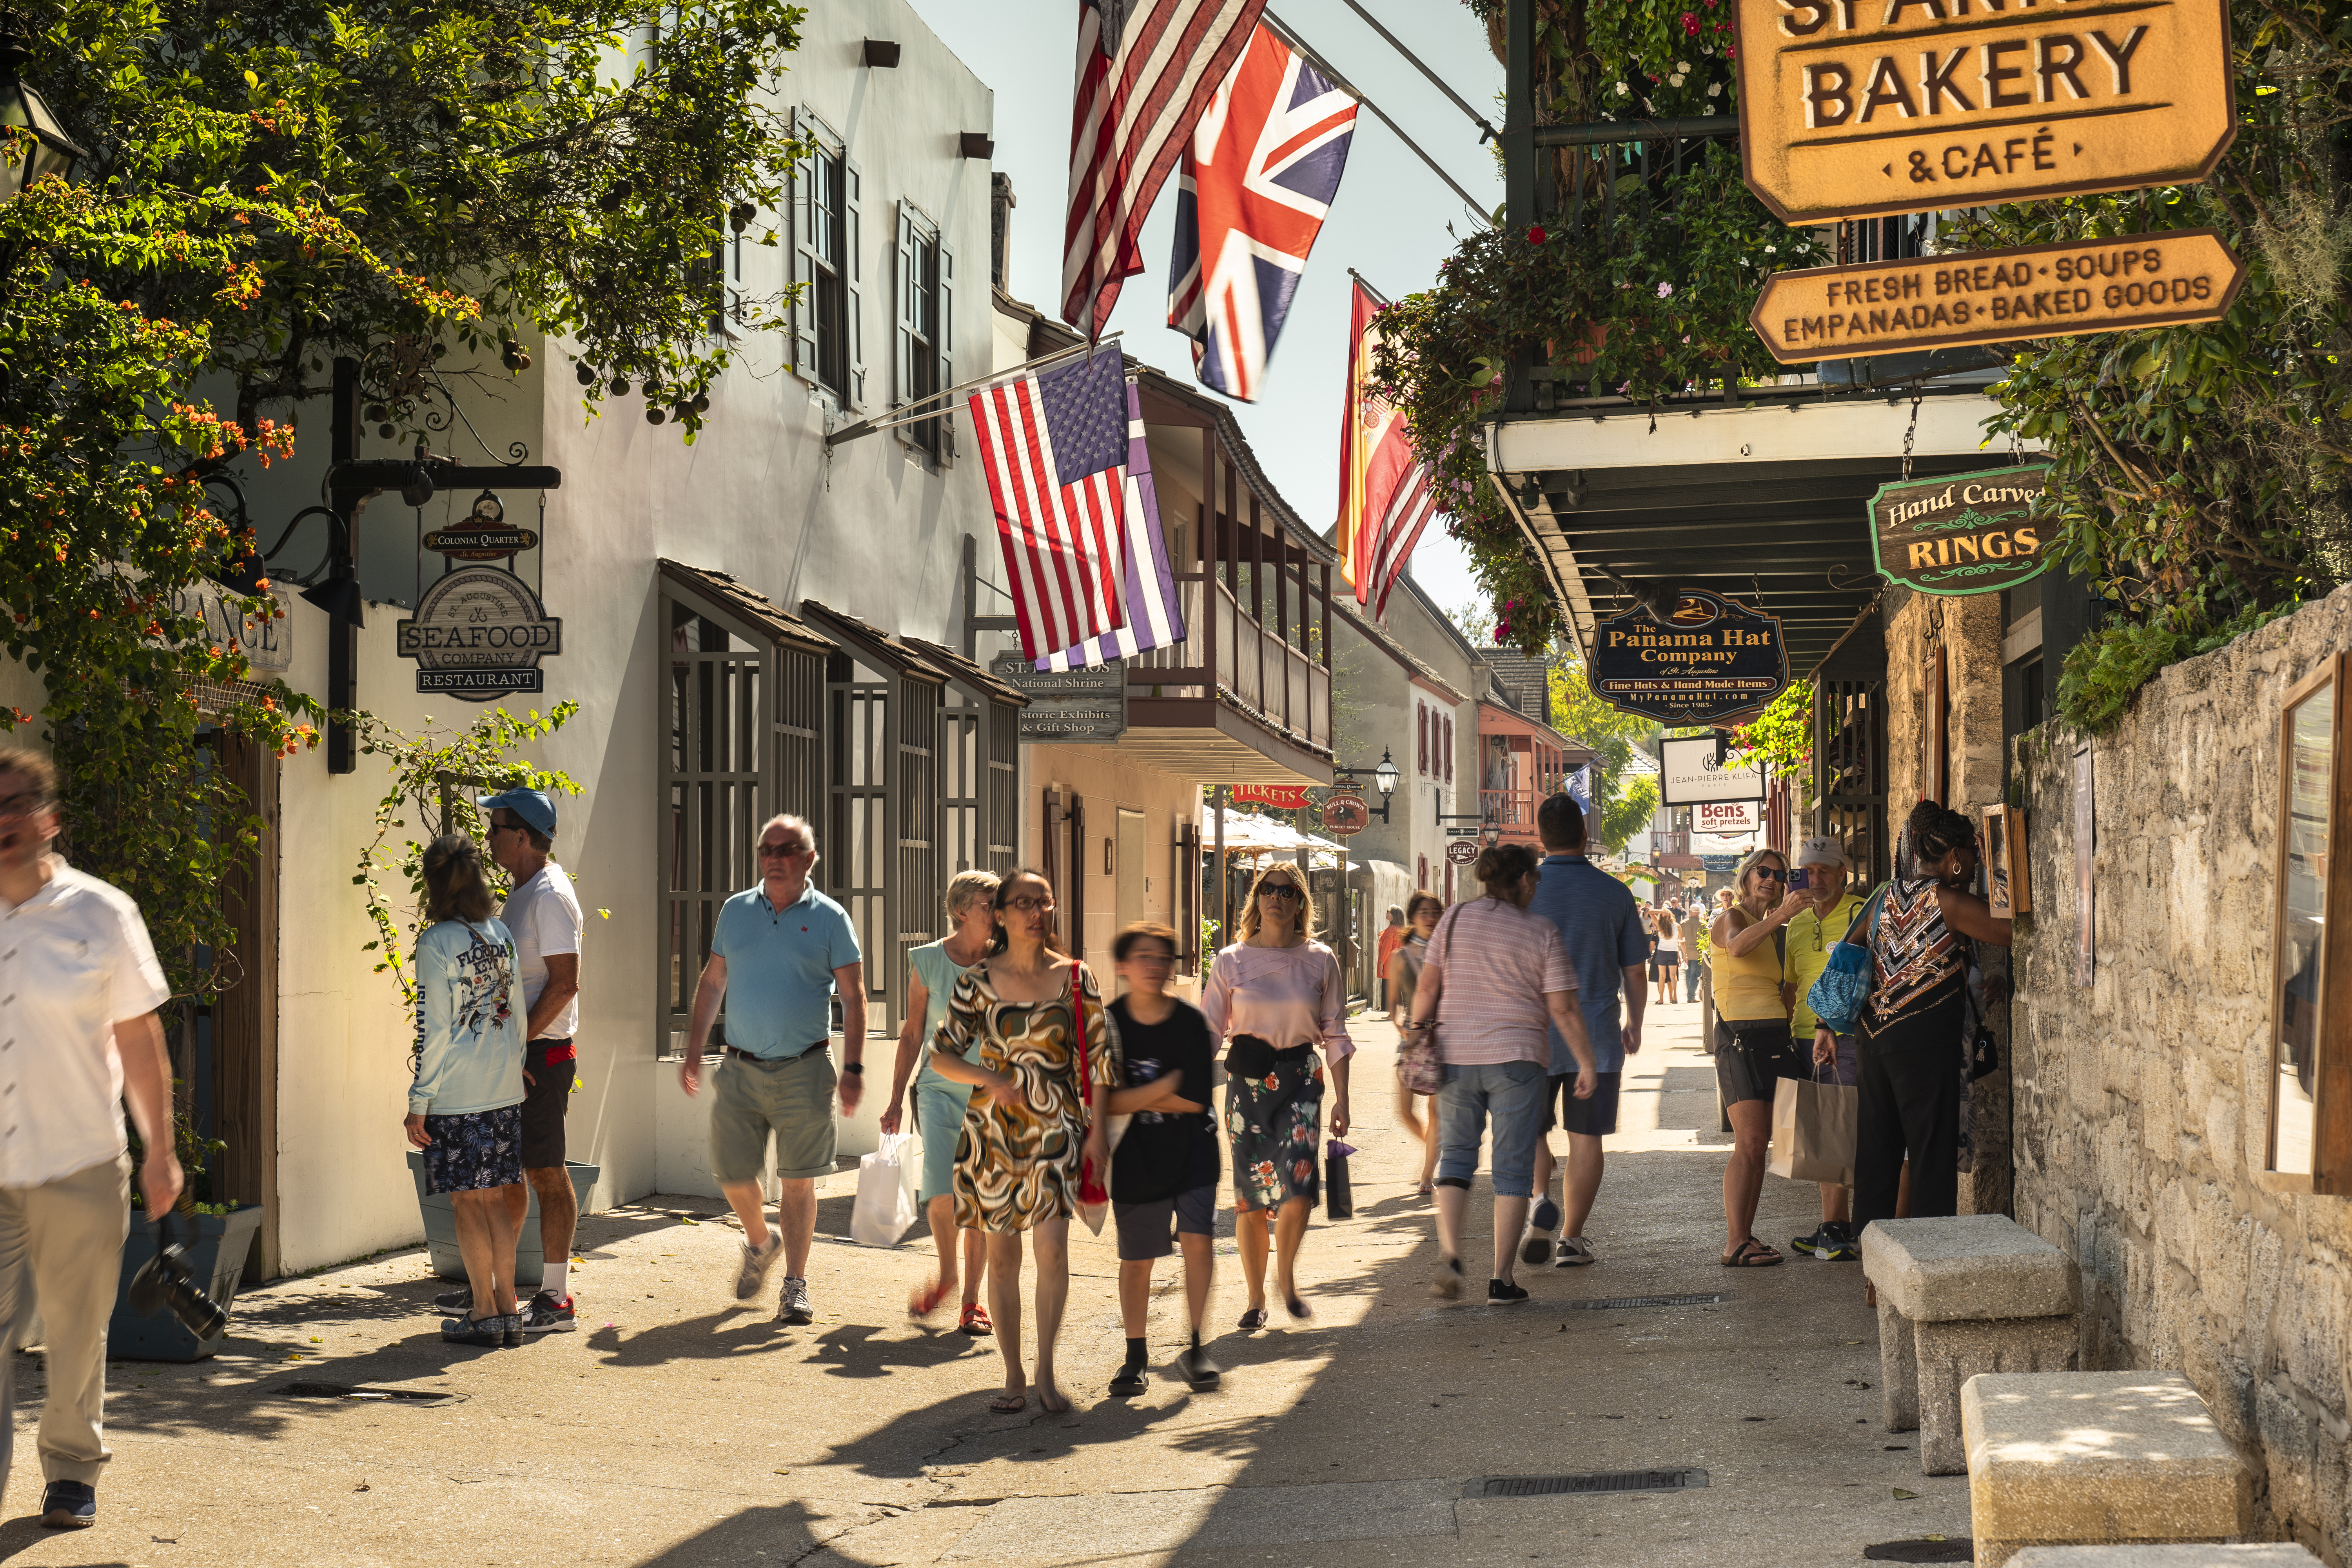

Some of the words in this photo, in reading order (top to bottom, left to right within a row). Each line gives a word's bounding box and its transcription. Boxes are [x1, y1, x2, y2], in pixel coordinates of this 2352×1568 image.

[1800, 25, 2149, 129] BAKERY
[1826, 274, 1921, 307] FRESH
[1934, 262, 2032, 296] BREAD
[2055, 248, 2161, 282] SOUPS
[1783, 301, 1969, 342] EMPANADAS
[1991, 288, 2090, 321] BAKED
[2103, 276, 2211, 309] GOODS
[1888, 484, 1956, 529] Hand
[437, 535, 478, 545] COLONIAL
[481, 535, 519, 546] QUARTER
[1907, 526, 2040, 570] RINGS
[448, 605, 460, 618] ST.
[461, 592, 508, 617] AUGUSTINE
[1633, 624, 1657, 633] The
[405, 626, 551, 649] SEAFOOD
[1608, 631, 1713, 647] Panama
[1721, 629, 1771, 646] Hat
[441, 653, 515, 664] COMPANY
[1640, 649, 1737, 665] Company
[1005, 662, 1027, 673] ST.
[1659, 666, 1671, 676] of
[1681, 666, 1719, 677] Augustine
[422, 673, 533, 686] RESTAURANT
[1011, 678, 1062, 688] National
[1065, 678, 1104, 688] Shrine
[1609, 681, 1631, 690] Fine
[1674, 681, 1702, 689] Hand
[1705, 680, 1734, 688] Made
[1737, 679, 1768, 688] Items
[1630, 693, 1748, 703] MyPanamaHat.com
[1020, 710, 1055, 719] storic
[1059, 710, 1111, 719] Exhibits
[1021, 723, 1033, 731] &
[1036, 723, 1060, 731] Gift
[1064, 722, 1095, 734] Shop
[1671, 774, 1729, 784] JEAN-PIERRE
[1237, 785, 1296, 802] TICKETS
[1326, 800, 1340, 810] BULL
[1345, 799, 1365, 811] CROWN
[1720, 817, 1751, 827] pretzels
[456, 944, 508, 967] FLORDA
